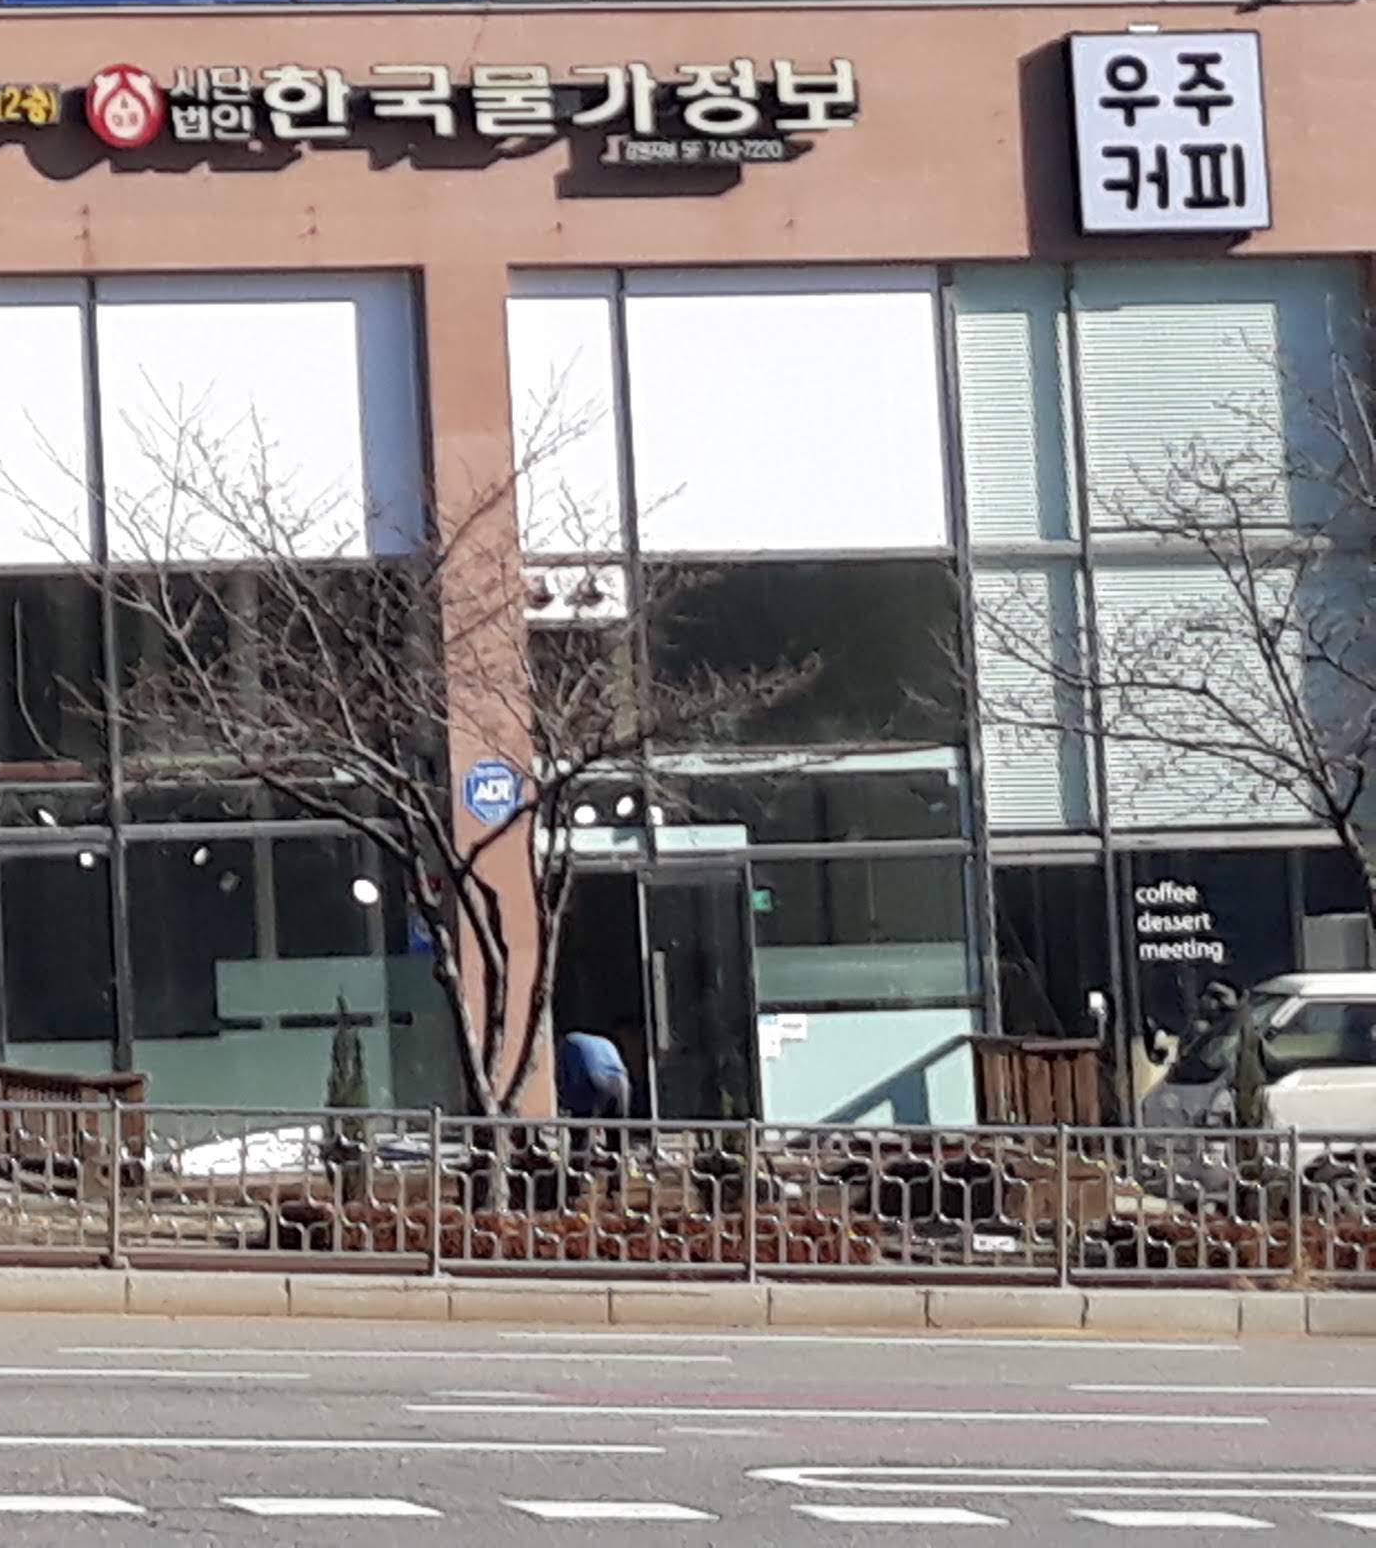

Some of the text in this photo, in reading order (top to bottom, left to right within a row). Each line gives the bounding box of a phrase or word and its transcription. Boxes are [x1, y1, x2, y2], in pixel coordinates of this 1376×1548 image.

[261, 58, 860, 140] 한국물가정보
[1098, 51, 1235, 128] 우주
[170, 104, 255, 142] 법인
[1101, 142, 1247, 212] 커피
[1134, 880, 1199, 905] coffee
[1136, 911, 1212, 934] dessert
[1139, 937, 1225, 964] meeting
